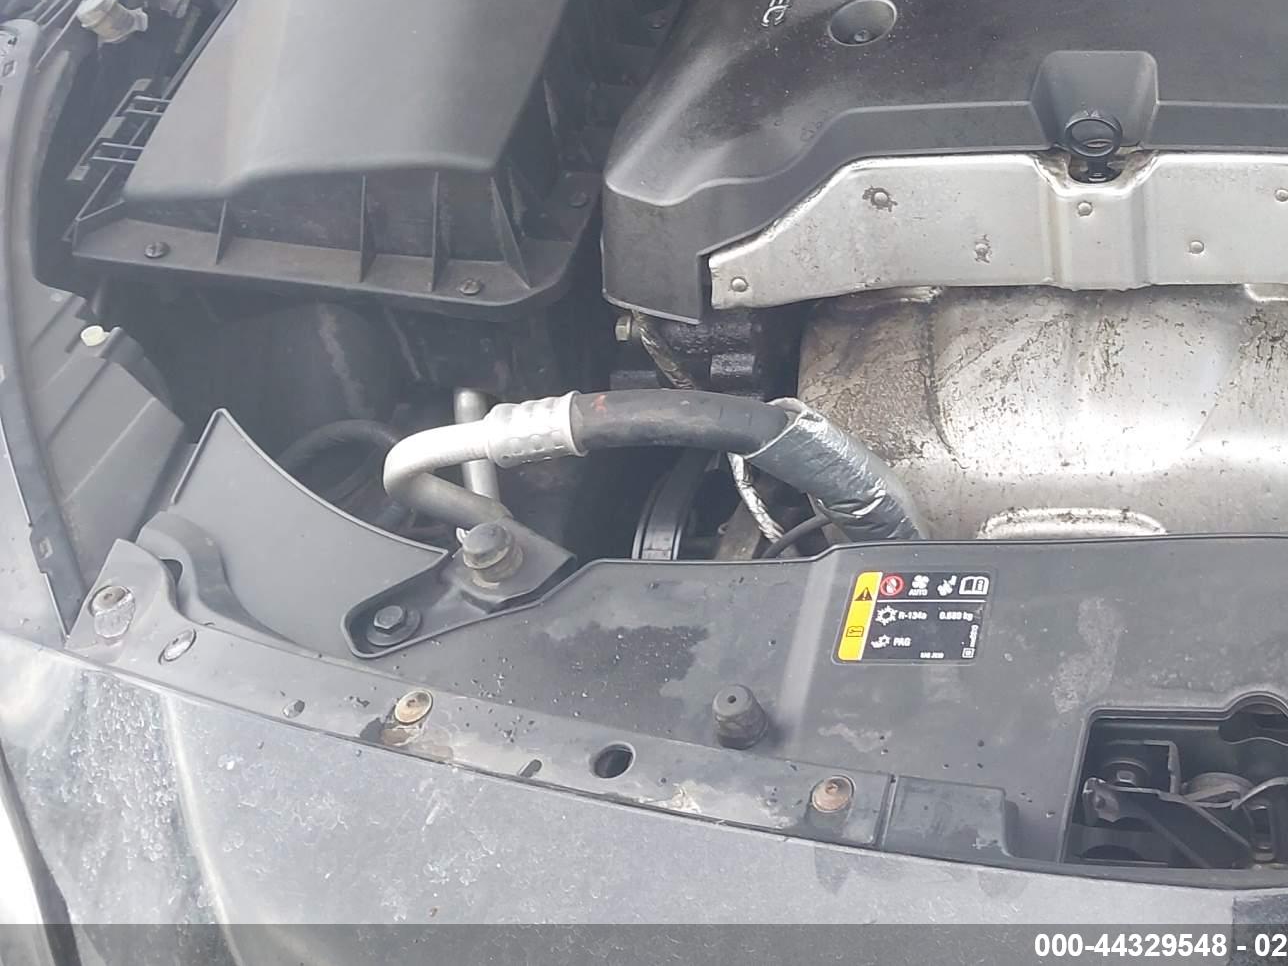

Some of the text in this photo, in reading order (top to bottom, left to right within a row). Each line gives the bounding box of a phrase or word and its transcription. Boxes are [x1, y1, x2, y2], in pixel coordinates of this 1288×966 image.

[908, 588, 928, 596] AUTO
[898, 611, 928, 620] R-134a
[893, 636, 912, 647] PAG
